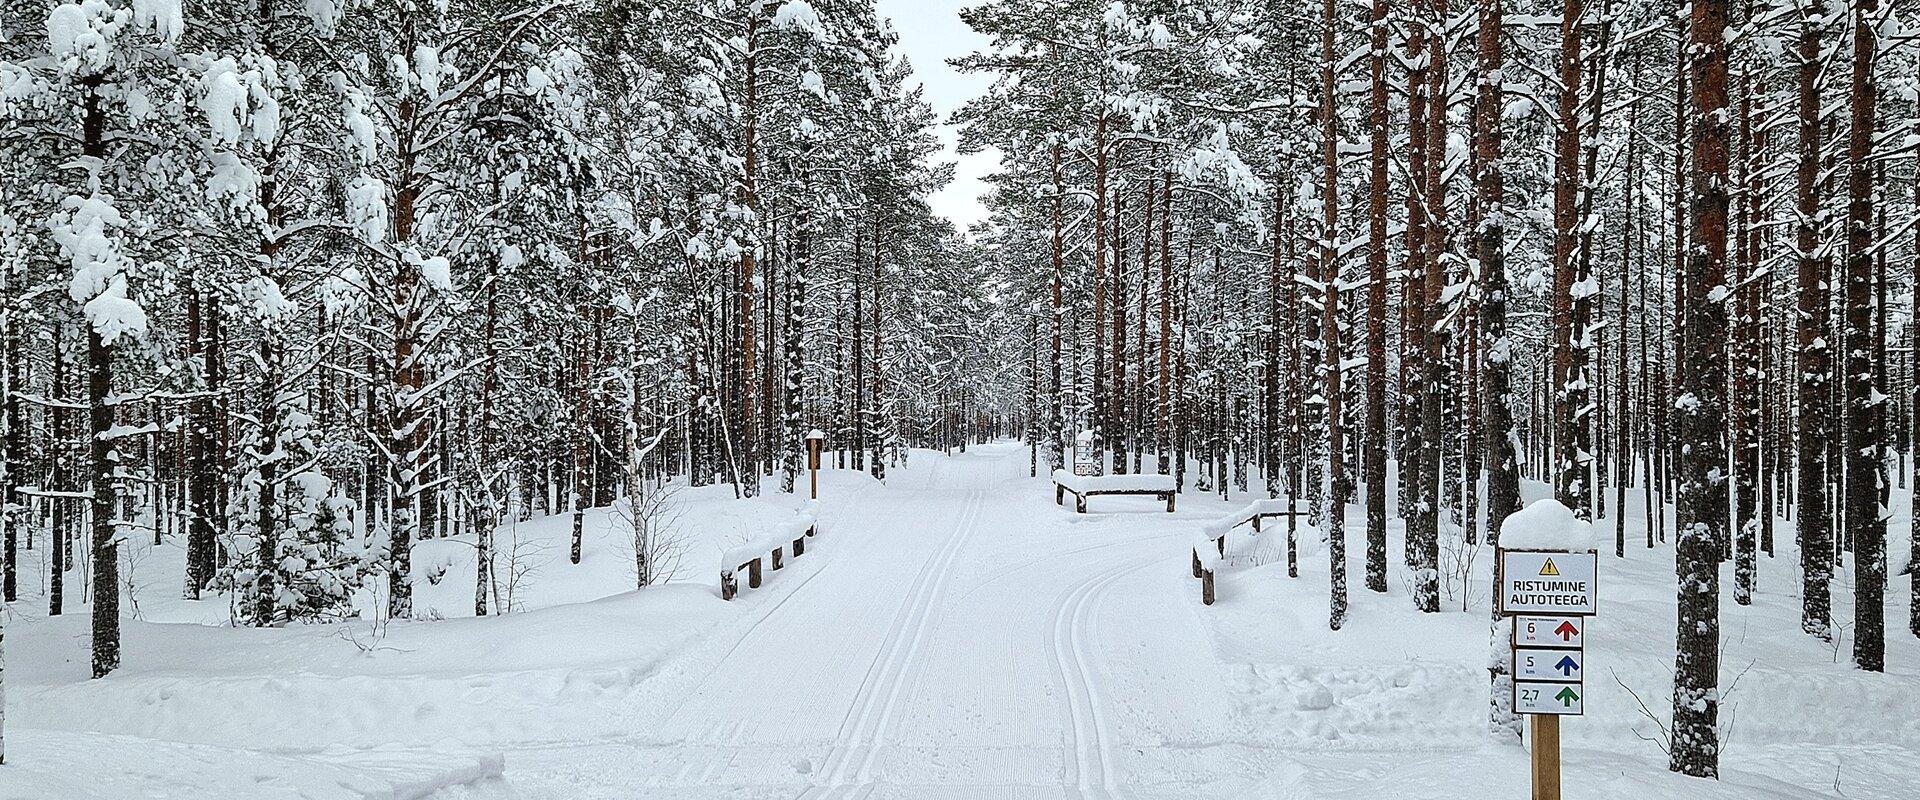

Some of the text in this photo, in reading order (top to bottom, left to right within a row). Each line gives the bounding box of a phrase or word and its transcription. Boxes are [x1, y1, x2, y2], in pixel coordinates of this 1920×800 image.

[1513, 580, 1586, 592] RISTUMINE
[1510, 594, 1588, 606] AUTOTEEGA
[1527, 622, 1536, 633] 6
[1526, 656, 1534, 667] 5
[1521, 689, 1540, 702] 2,7
